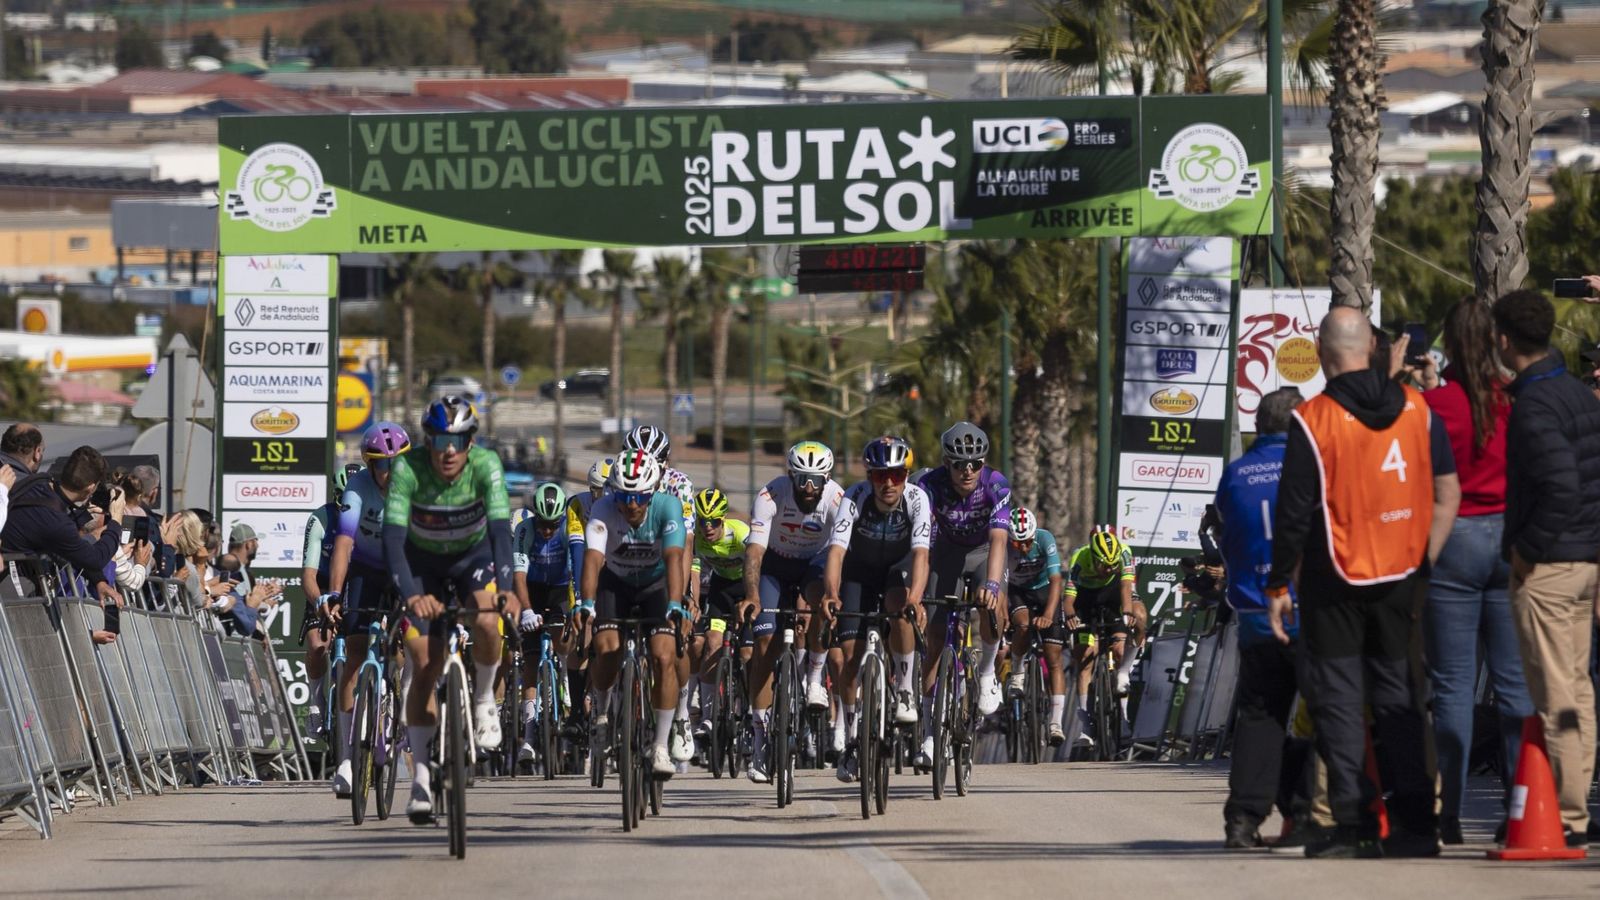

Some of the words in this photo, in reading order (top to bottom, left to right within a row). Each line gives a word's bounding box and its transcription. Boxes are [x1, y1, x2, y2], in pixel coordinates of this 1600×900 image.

[359, 119, 518, 154] VUELTA
[538, 115, 725, 150] CICLISTA
[979, 125, 1031, 147] UCI
[1074, 122, 1100, 135] PRO
[1074, 133, 1116, 145] SERIES
[711, 127, 897, 183] RUTA
[359, 159, 391, 193] A
[401, 141, 664, 191] ANDALUCÍA
[976, 165, 1059, 184] ALHAURÍN
[1061, 168, 1080, 182] DE
[684, 156, 711, 235] 2025
[977, 184, 996, 197] LA
[1000, 182, 1049, 197] TORRE
[1031, 202, 1134, 229] ARRIVÈE
[358, 225, 428, 245] META
[1162, 285, 1181, 294] Red
[1183, 286, 1221, 295] Renault
[1162, 293, 1175, 301] de
[260, 305, 279, 313] Red
[281, 305, 319, 313] Renault
[1130, 320, 1208, 337] GSPORT
[228, 341, 307, 356] GSPORT
[1160, 351, 1194, 361] AQUA
[1161, 360, 1192, 369] DEUS
[229, 374, 323, 388] AQUAMARINA
[1381, 438, 1407, 483] 4
[1247, 472, 1282, 485] OFICIA
[241, 486, 309, 498] GARCIDEN
